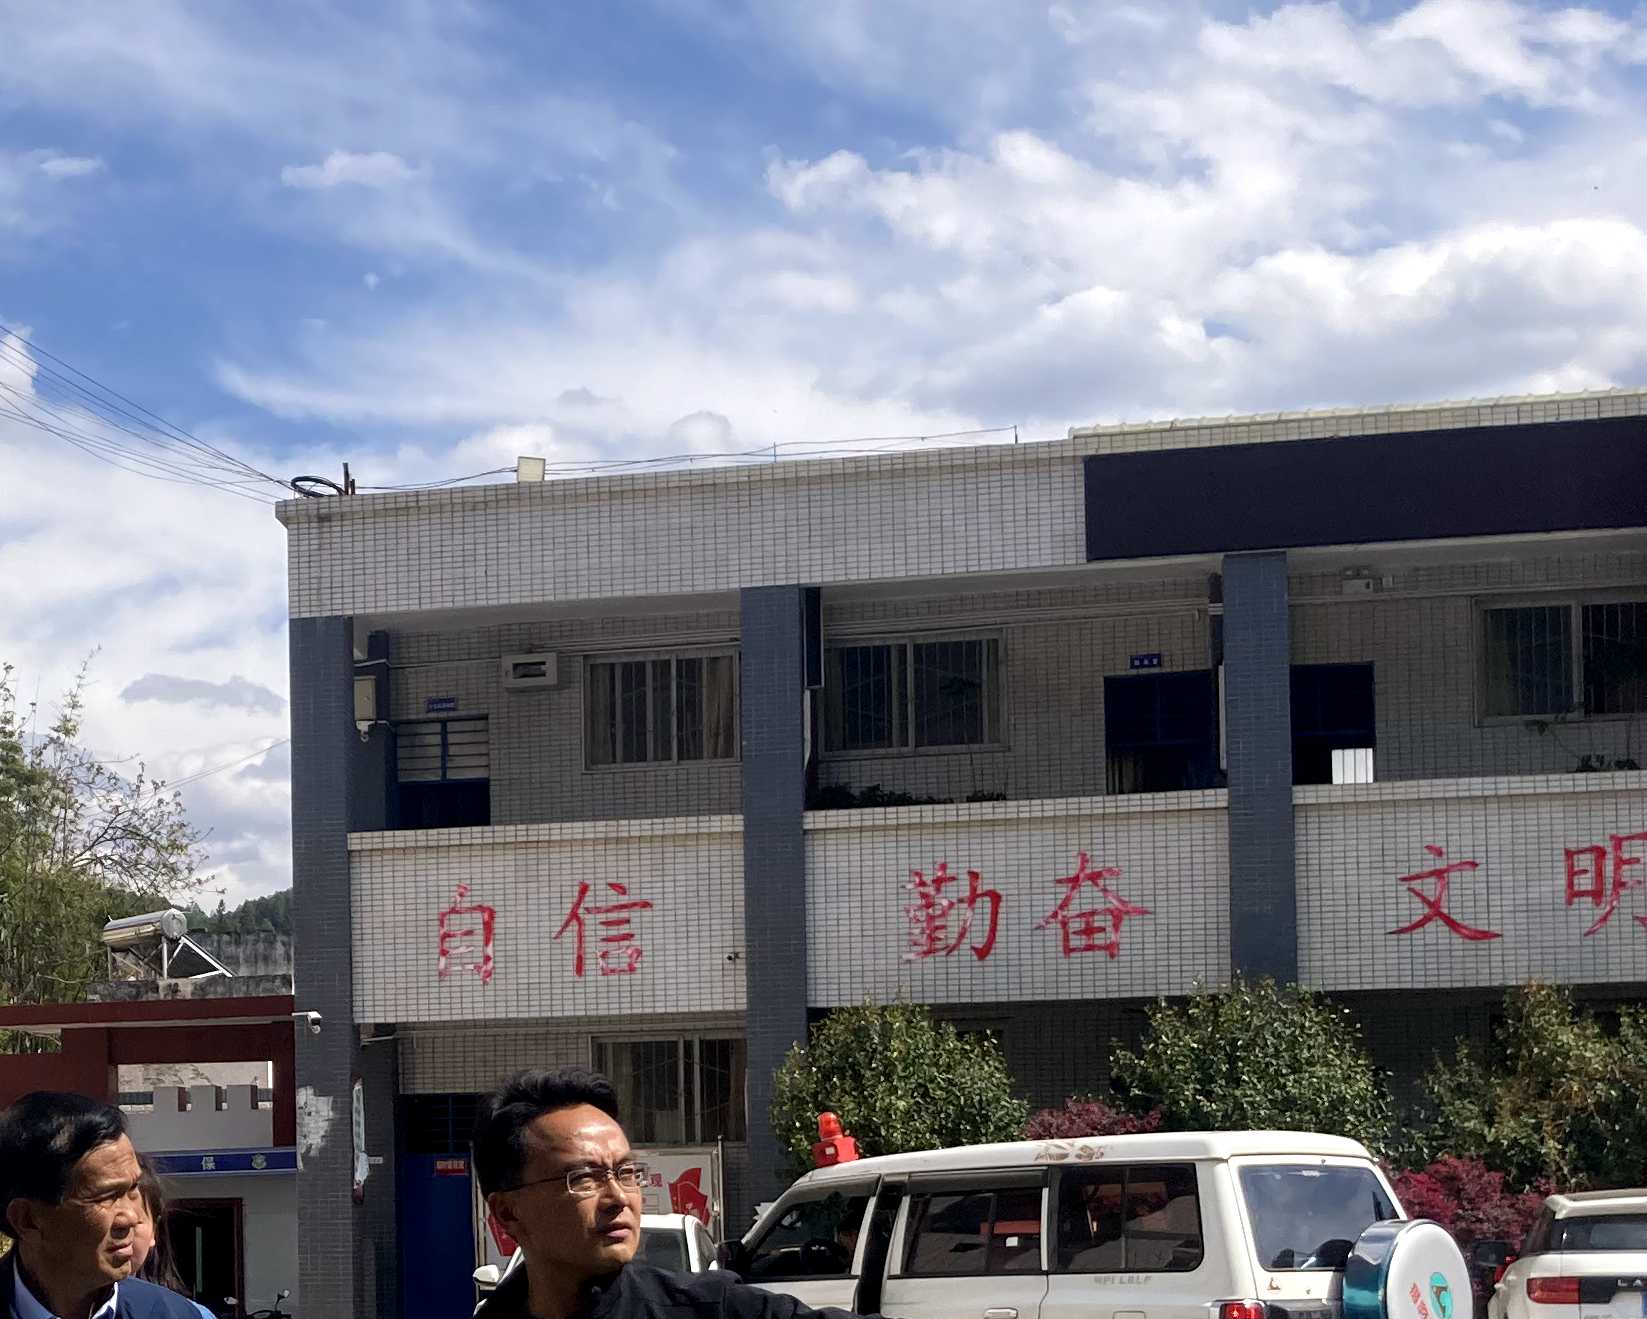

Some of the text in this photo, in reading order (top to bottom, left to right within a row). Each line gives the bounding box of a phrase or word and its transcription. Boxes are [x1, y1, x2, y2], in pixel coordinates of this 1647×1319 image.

[437, 879, 655, 985] 自信
[903, 849, 1155, 965] 勤奋
[1386, 830, 1647, 944] 文明
